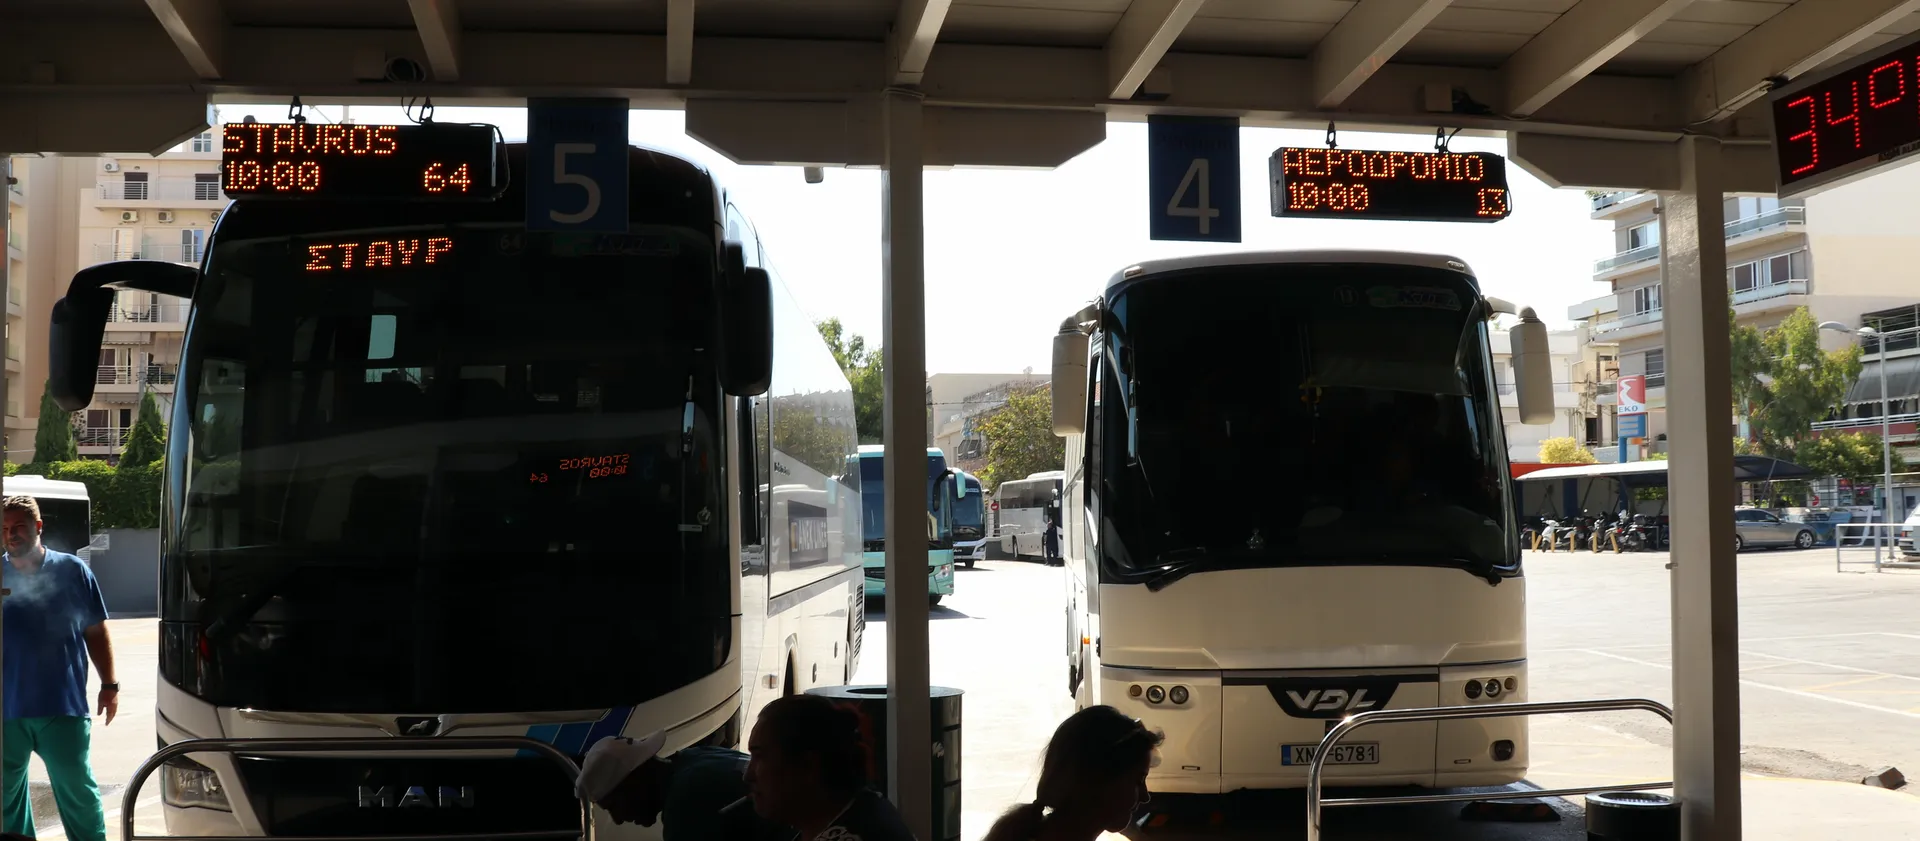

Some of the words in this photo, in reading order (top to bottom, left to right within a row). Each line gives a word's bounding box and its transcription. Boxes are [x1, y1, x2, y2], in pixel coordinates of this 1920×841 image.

[1787, 55, 1920, 175] 34°
[222, 122, 397, 154] STAVROS
[225, 160, 321, 191] 10:00
[423, 162, 472, 193] 64
[1283, 147, 1484, 182] ΑΕΡΟΔΡΟΜΙΟ
[549, 142, 602, 224] 5
[1166, 158, 1220, 235] 4
[1288, 182, 1370, 211] 10:00
[1477, 187, 1506, 216] 13
[304, 236, 453, 271] ΣΤΑΥΡ
[1285, 688, 1377, 711] VDL
[1294, 745, 1376, 764] XN-6781
[358, 785, 475, 808] MAN
